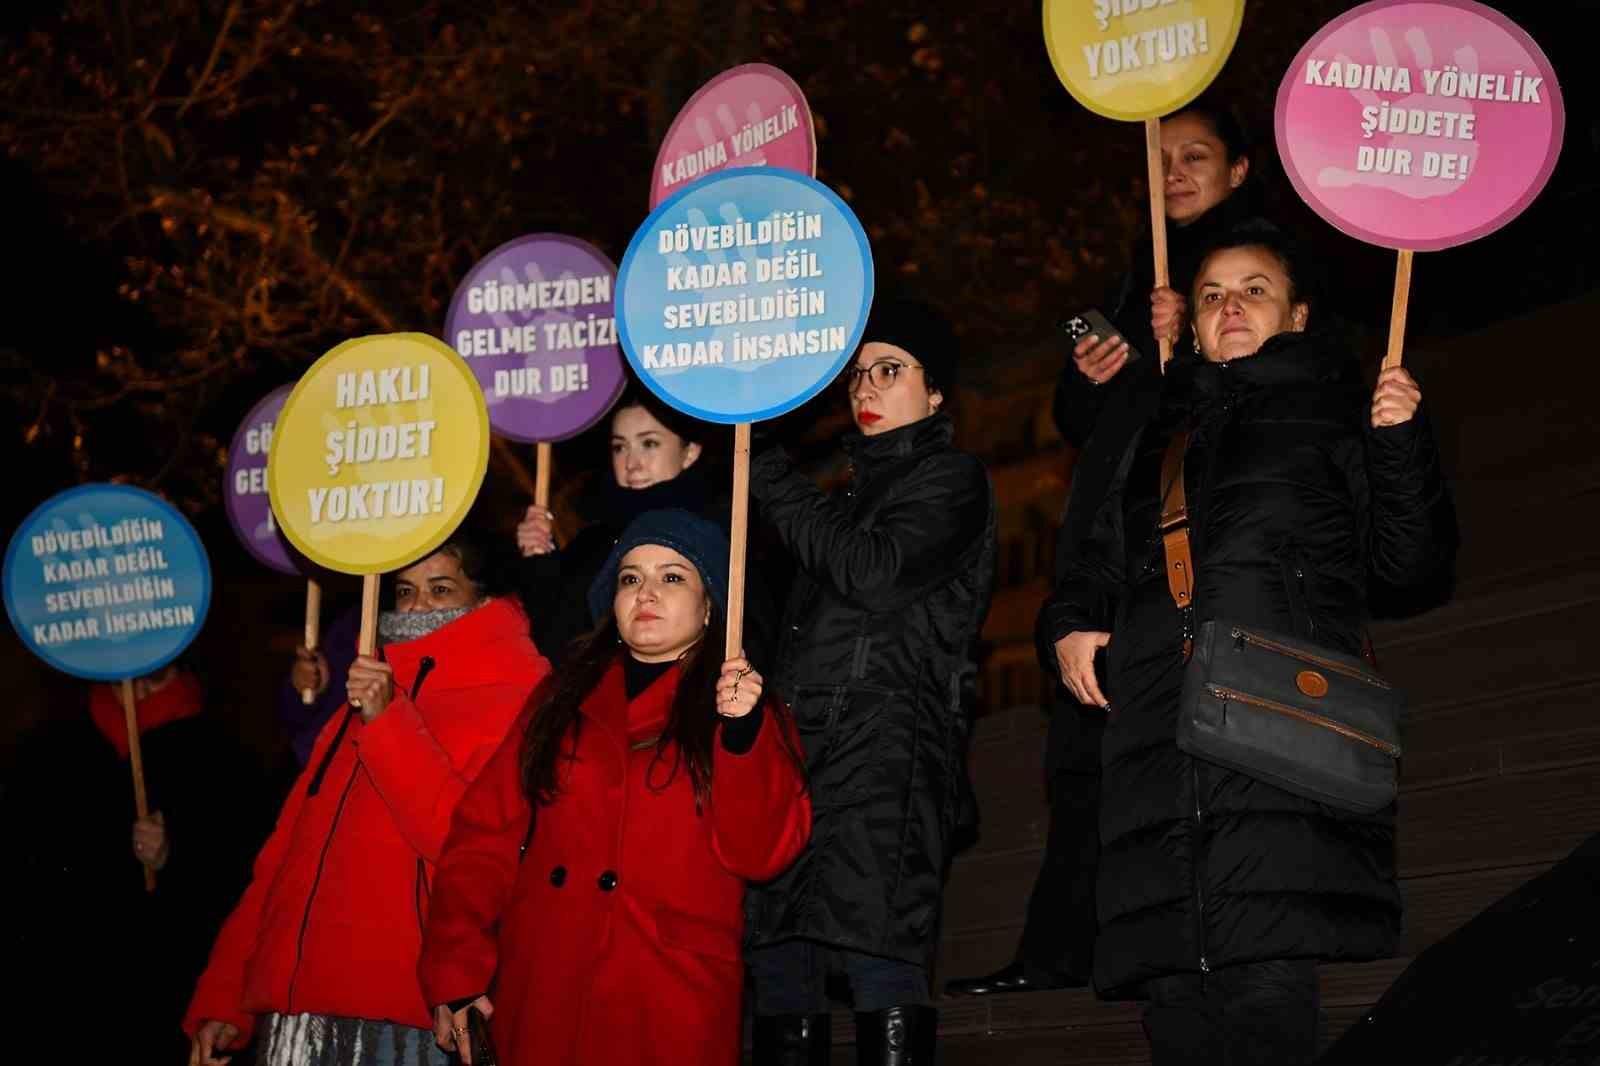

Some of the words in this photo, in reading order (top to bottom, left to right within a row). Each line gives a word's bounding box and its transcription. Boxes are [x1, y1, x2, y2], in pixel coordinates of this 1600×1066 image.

[1082, 17, 1209, 80] YOKTUR!
[1305, 59, 1412, 94] KADINA
[1424, 65, 1544, 104] YÖNELİK
[1361, 101, 1476, 139] ŞİDDETE
[661, 140, 728, 187] KADINA
[731, 104, 798, 157] YÖNELİK
[1357, 146, 1412, 176] DUR
[1422, 151, 1471, 180] DE!
[658, 211, 822, 254] DÖVEBİLDİĞİN
[667, 260, 747, 291] KADAR
[756, 248, 822, 283] DEĞİL
[467, 275, 611, 314] GÖRMEZDEN
[663, 287, 825, 330] SEVEBİLDİĞİN
[456, 325, 537, 357] GELME
[643, 339, 724, 369] KADAR
[732, 326, 846, 362] İNSANSIN
[336, 364, 431, 408] HAKLI
[494, 367, 542, 397] DUR
[550, 363, 589, 393] DE!
[325, 420, 436, 476] ŞİDDET
[307, 477, 445, 524] YOKTUR!
[31, 517, 164, 557] DÖVEBİLDİĞİN
[43, 556, 110, 584] KADAR
[115, 546, 169, 576] DEĞİL
[46, 576, 175, 613] SEVEBİLDİĞİN
[34, 619, 99, 645] KADAR
[106, 605, 195, 635] İNSANSIN
